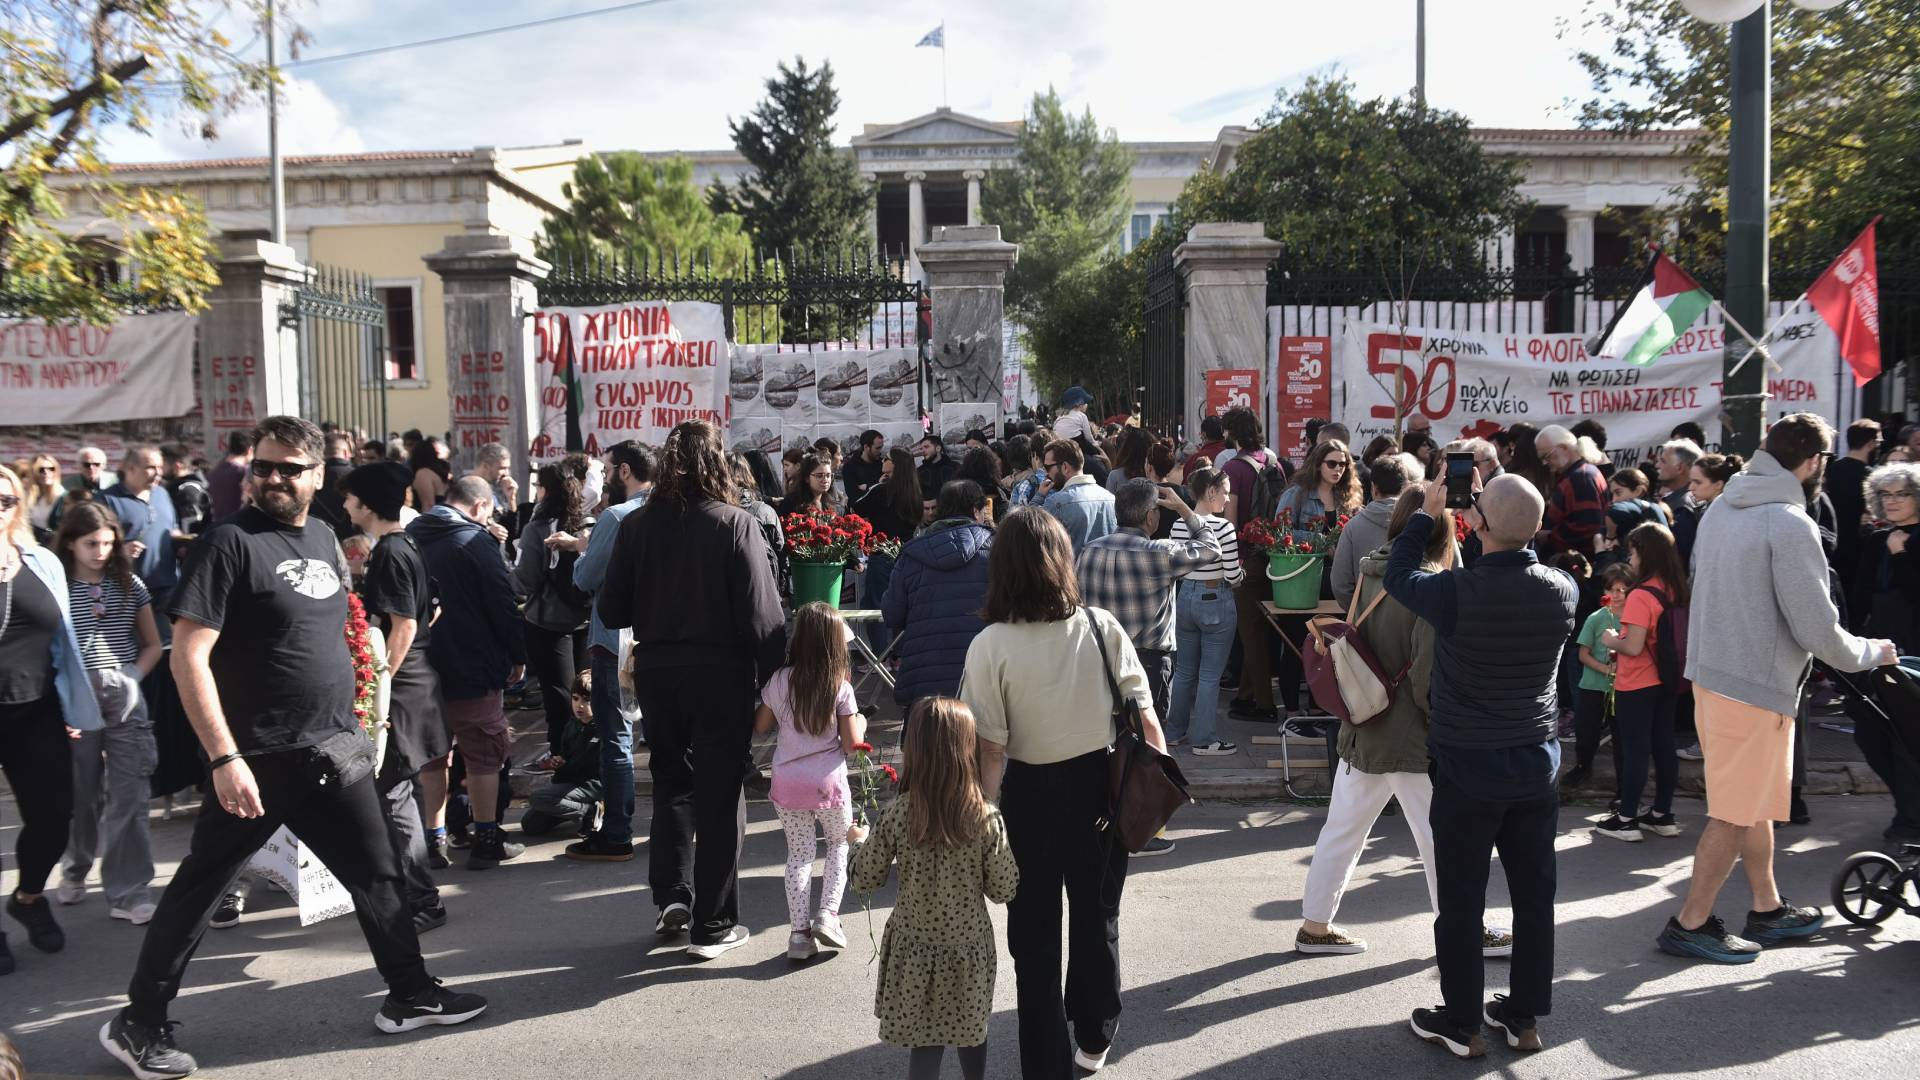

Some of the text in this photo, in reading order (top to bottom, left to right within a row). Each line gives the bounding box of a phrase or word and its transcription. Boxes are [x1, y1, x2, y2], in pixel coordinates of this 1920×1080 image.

[583, 306, 670, 341] ΧΡΟΝΙΑ
[1426, 337, 1488, 356] ΧΡΟΝΙΑ
[1505, 337, 1518, 359] Η
[1528, 338, 1588, 363] ΦΛΟΓΑ
[1299, 354, 1321, 379] 50
[1368, 333, 1456, 420] 50
